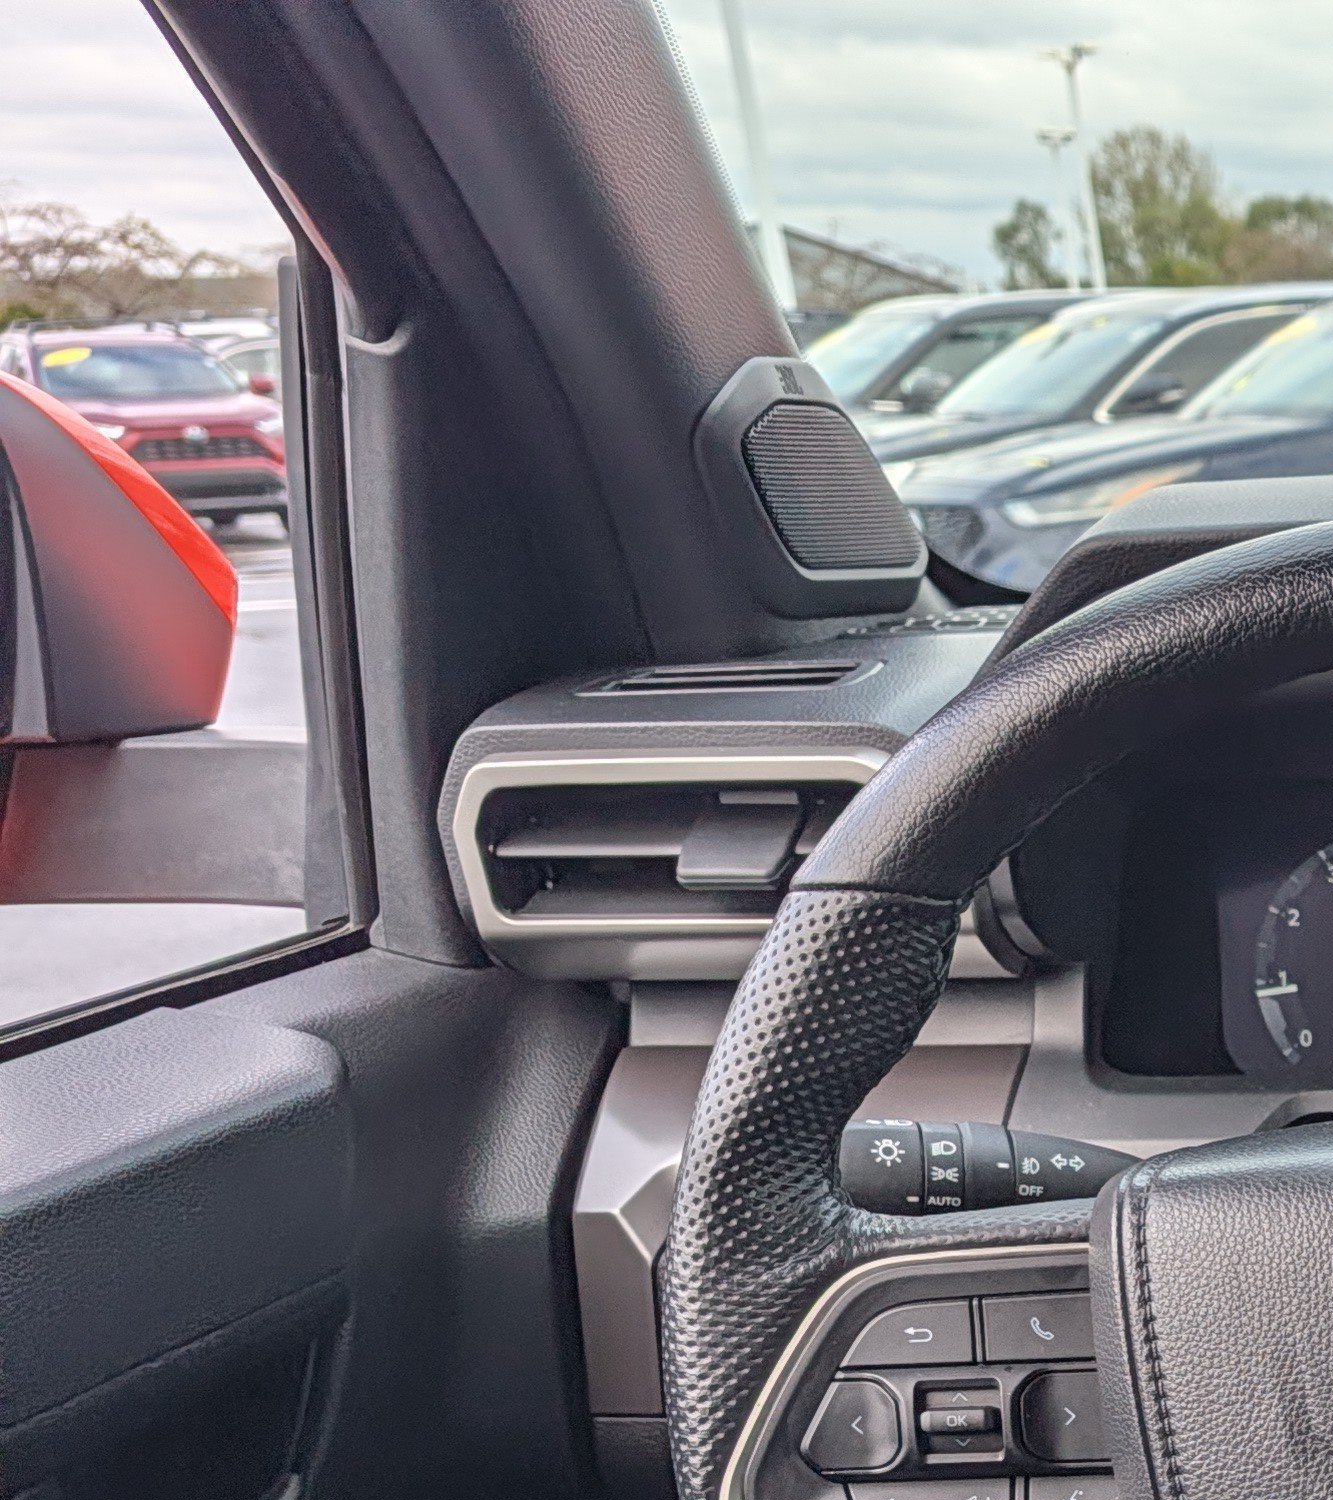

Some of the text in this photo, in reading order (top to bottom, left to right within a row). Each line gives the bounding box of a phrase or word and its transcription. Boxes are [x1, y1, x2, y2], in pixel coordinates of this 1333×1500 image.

[1287, 908, 1301, 927] 2
[1278, 969, 1288, 987] 1
[1299, 1028, 1314, 1048] 0
[1018, 1184, 1044, 1197] OFF
[927, 1196, 961, 1207] AUTO
[946, 1413, 968, 1427] OK
